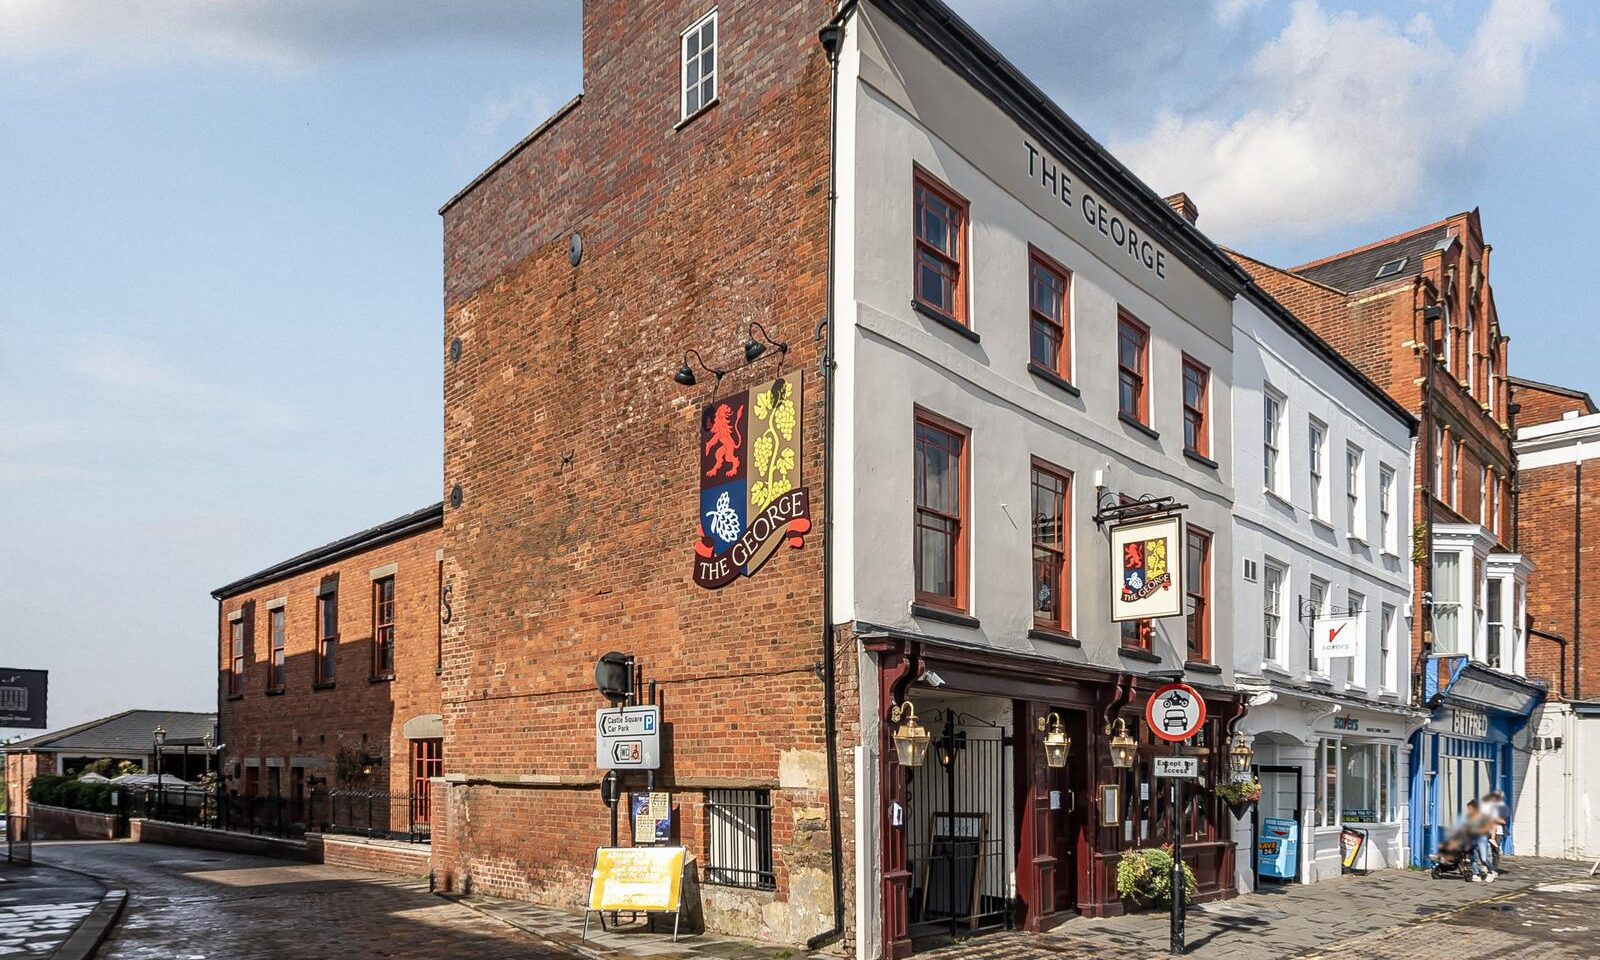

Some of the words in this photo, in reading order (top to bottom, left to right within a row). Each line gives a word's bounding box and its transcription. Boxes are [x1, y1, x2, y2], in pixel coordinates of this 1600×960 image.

[1024, 141, 1072, 208] THE
[1082, 193, 1166, 279] GEORGE
[700, 558, 730, 580] THE
[732, 492, 804, 566] GEORGE
[1124, 592, 1138, 602] THE
[1138, 574, 1169, 597] GEORGE
[624, 715, 643, 723] Square
[645, 716, 652, 730] P
